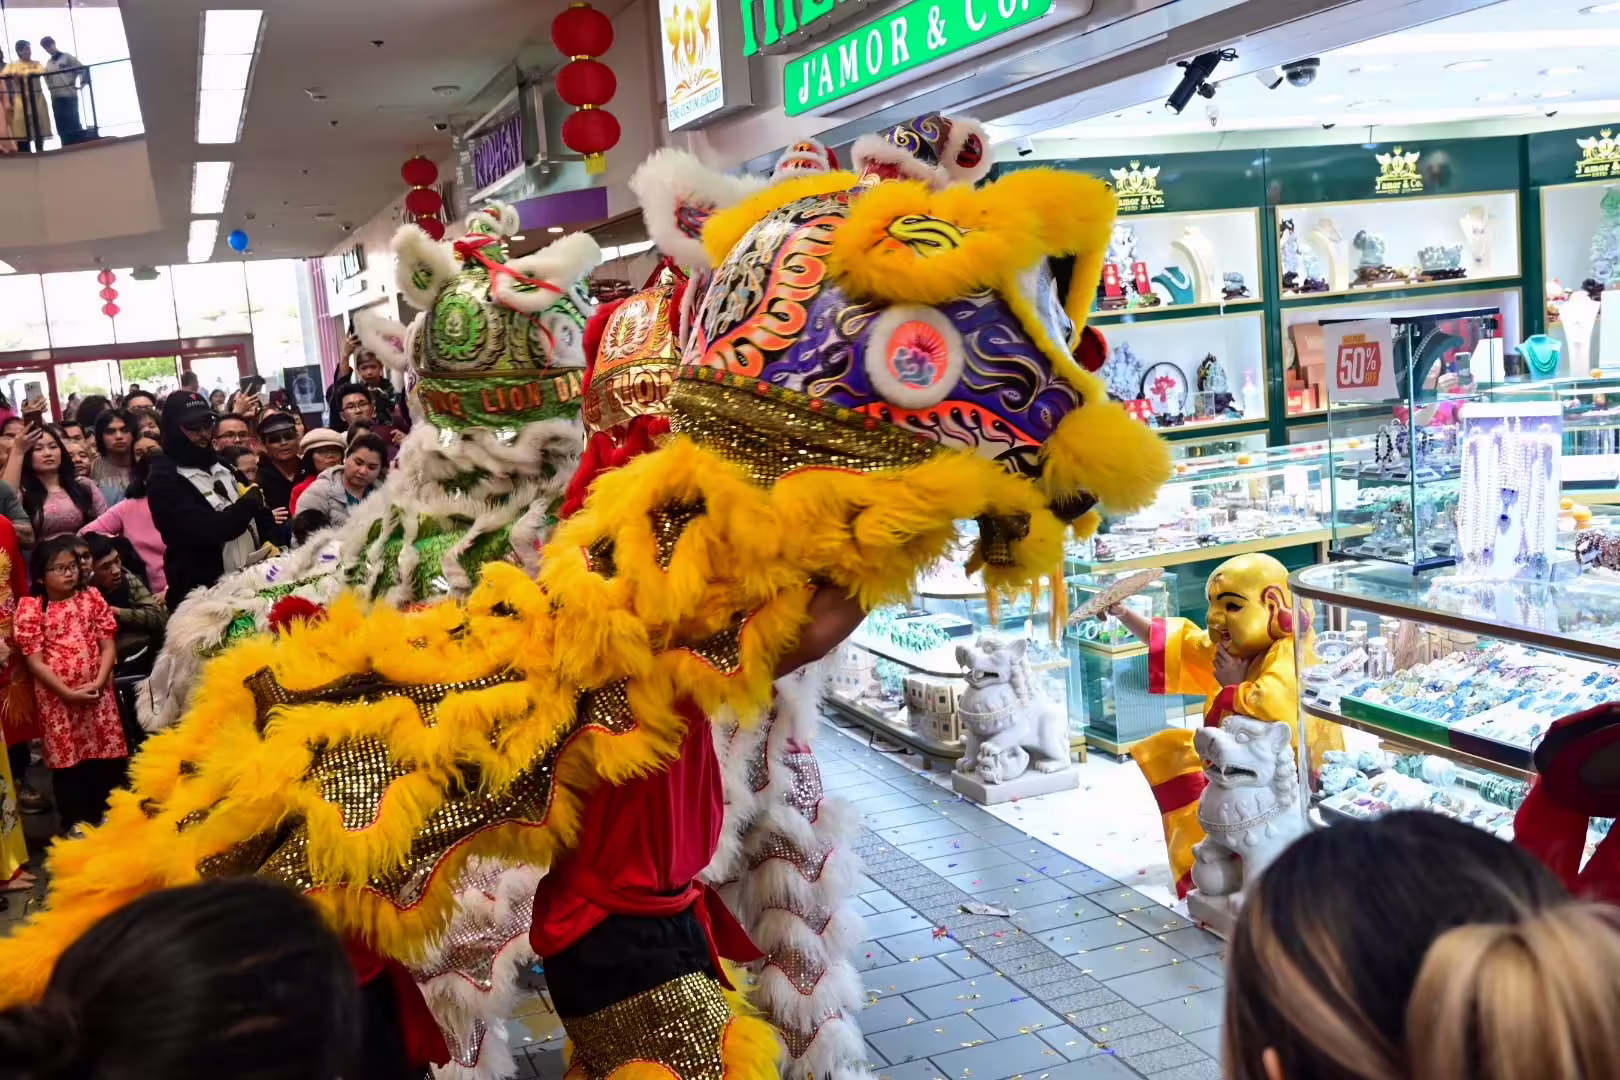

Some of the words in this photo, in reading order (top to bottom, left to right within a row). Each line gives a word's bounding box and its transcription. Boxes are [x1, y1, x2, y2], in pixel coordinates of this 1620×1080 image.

[798, 15, 910, 104] J'AMOR
[927, 5, 948, 50] &
[1402, 179, 1409, 188] &
[1410, 179, 1423, 188] Co.
[1118, 198, 1140, 207] amor
[1141, 195, 1149, 205] &
[1150, 194, 1164, 205] Co.
[1340, 346, 1377, 386] 50%
[481, 382, 543, 413] LION
